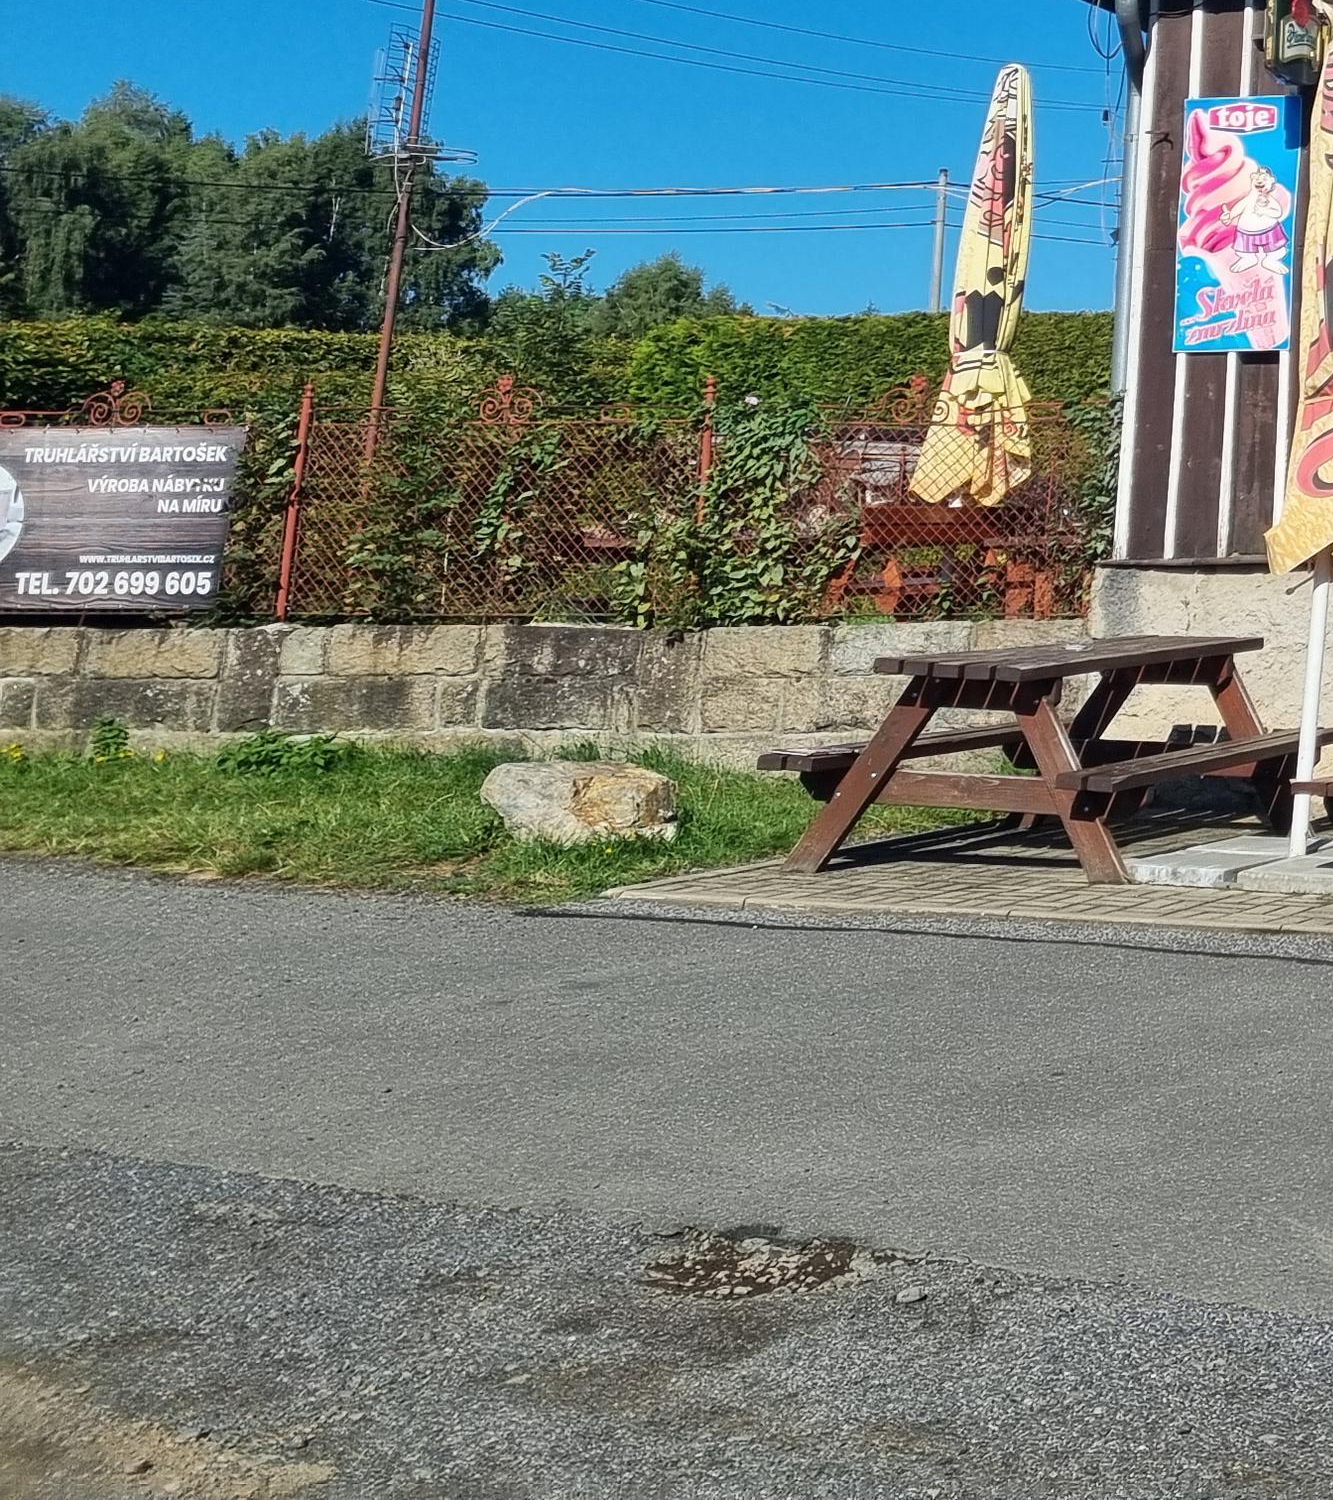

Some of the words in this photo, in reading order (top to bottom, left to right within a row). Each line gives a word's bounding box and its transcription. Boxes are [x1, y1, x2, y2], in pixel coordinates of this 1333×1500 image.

[24, 442, 138, 463] TRUHLÁŘSTVÍ
[139, 442, 228, 462] BARTOŠEK
[88, 475, 148, 493] VÝROBA
[157, 499, 179, 513] NA
[182, 494, 222, 513] MÍRU
[15, 572, 59, 595] TEL.
[65, 571, 110, 595] 702
[114, 571, 160, 595] 699
[165, 571, 212, 595] 605
